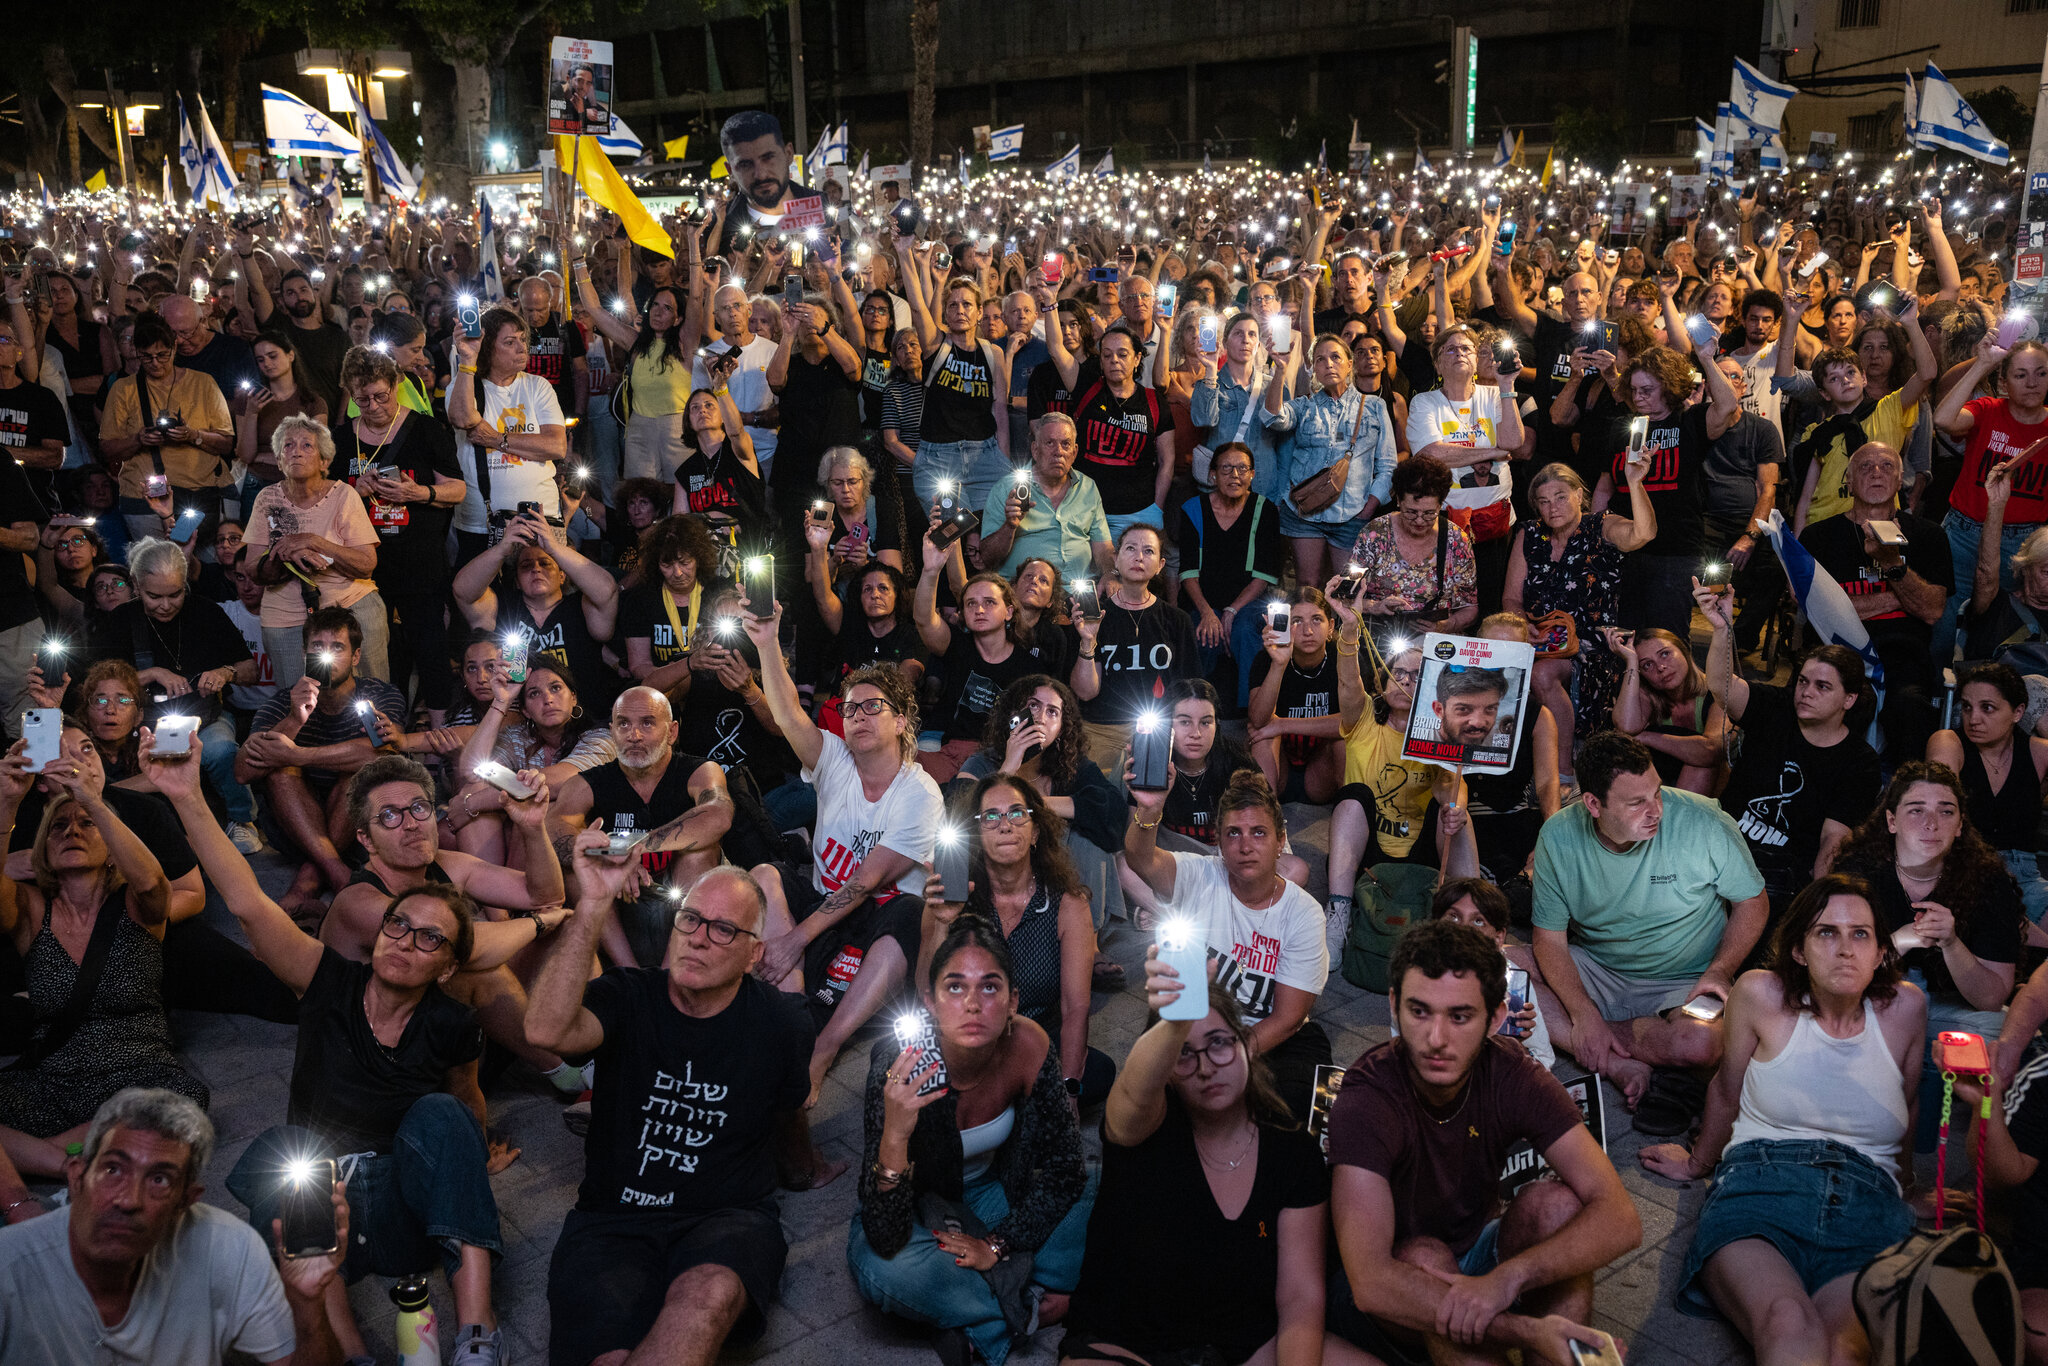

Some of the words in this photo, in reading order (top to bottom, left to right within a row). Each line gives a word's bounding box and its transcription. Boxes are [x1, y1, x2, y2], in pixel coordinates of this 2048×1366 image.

[1086, 419, 1147, 461] עכשיו
[1101, 643, 1173, 673] 7.10
[1459, 648, 1475, 657] DAVID
[1476, 650, 1493, 659] CUNIO
[1469, 658, 1480, 666] (33)
[1410, 727, 1429, 740] HIM
[1413, 716, 1442, 730] BRING
[1407, 740, 1436, 755] HOME
[1436, 743, 1464, 757] NOW!
[1737, 810, 1790, 847] NOW
[654, 1060, 728, 1101] שלום
[638, 1143, 700, 1177] צדק
[621, 1186, 675, 1207] נאמנים
